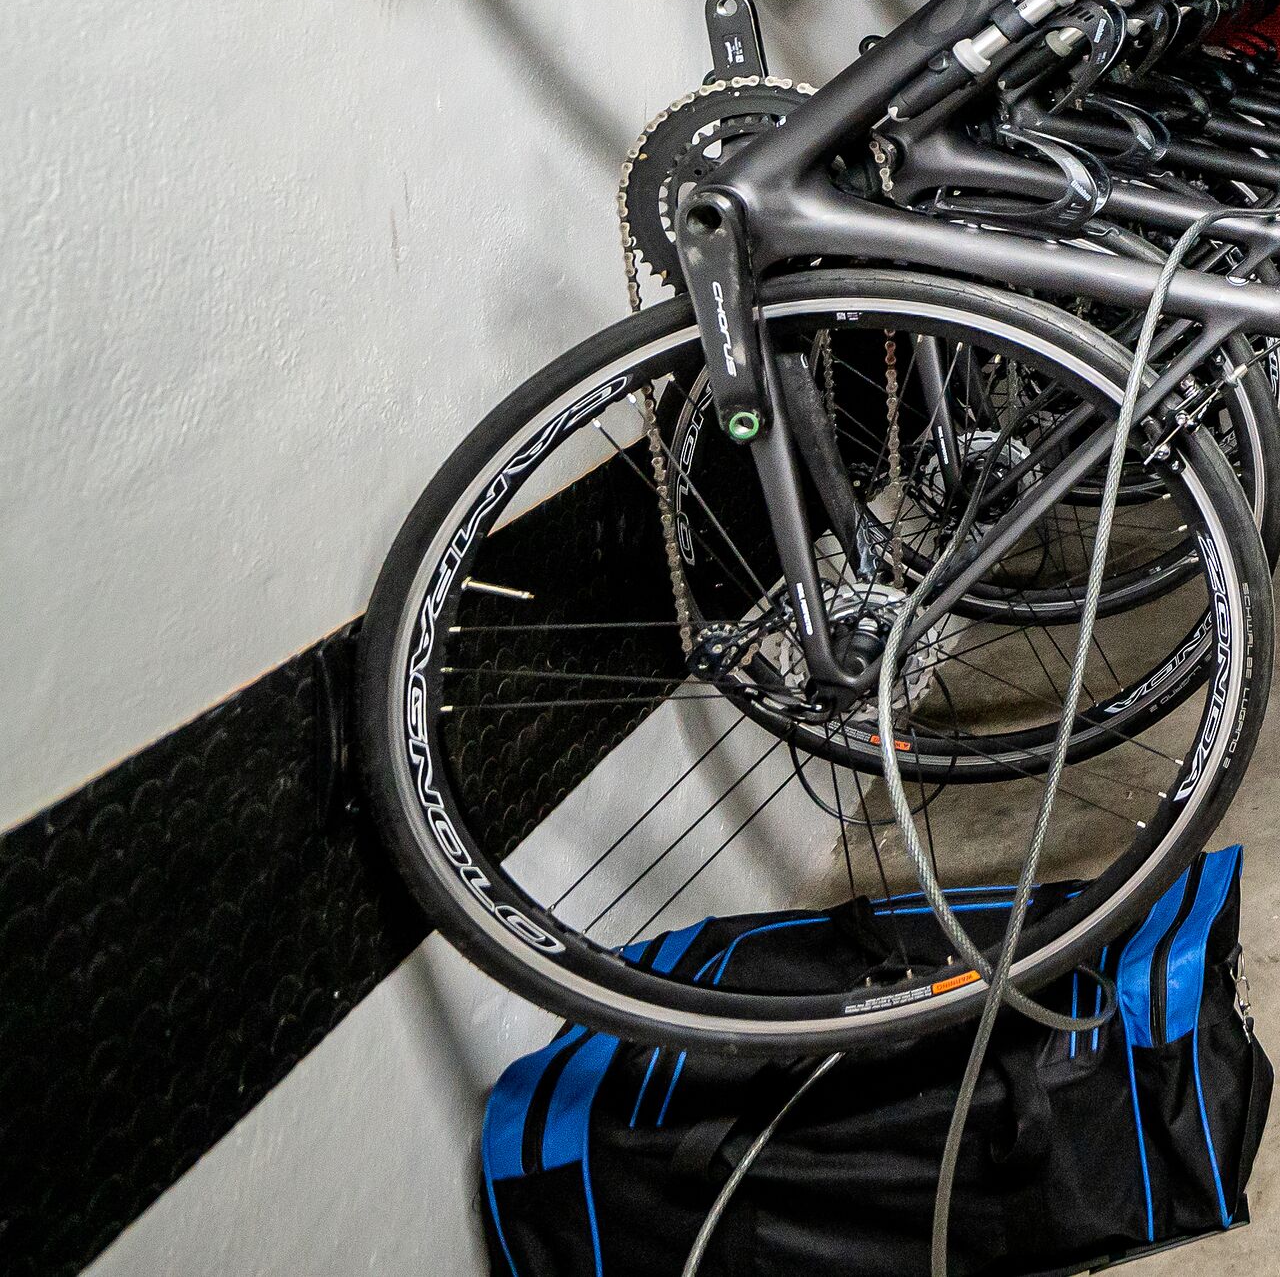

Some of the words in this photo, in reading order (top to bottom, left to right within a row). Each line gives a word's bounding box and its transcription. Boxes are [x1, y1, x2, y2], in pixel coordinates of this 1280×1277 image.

[404, 375, 632, 955] CAMPAGNOLO
[1197, 534, 1232, 802] ZONDA
[1226, 688, 1251, 753] LUGANO
[1241, 581, 1254, 679] SCHWALBE
